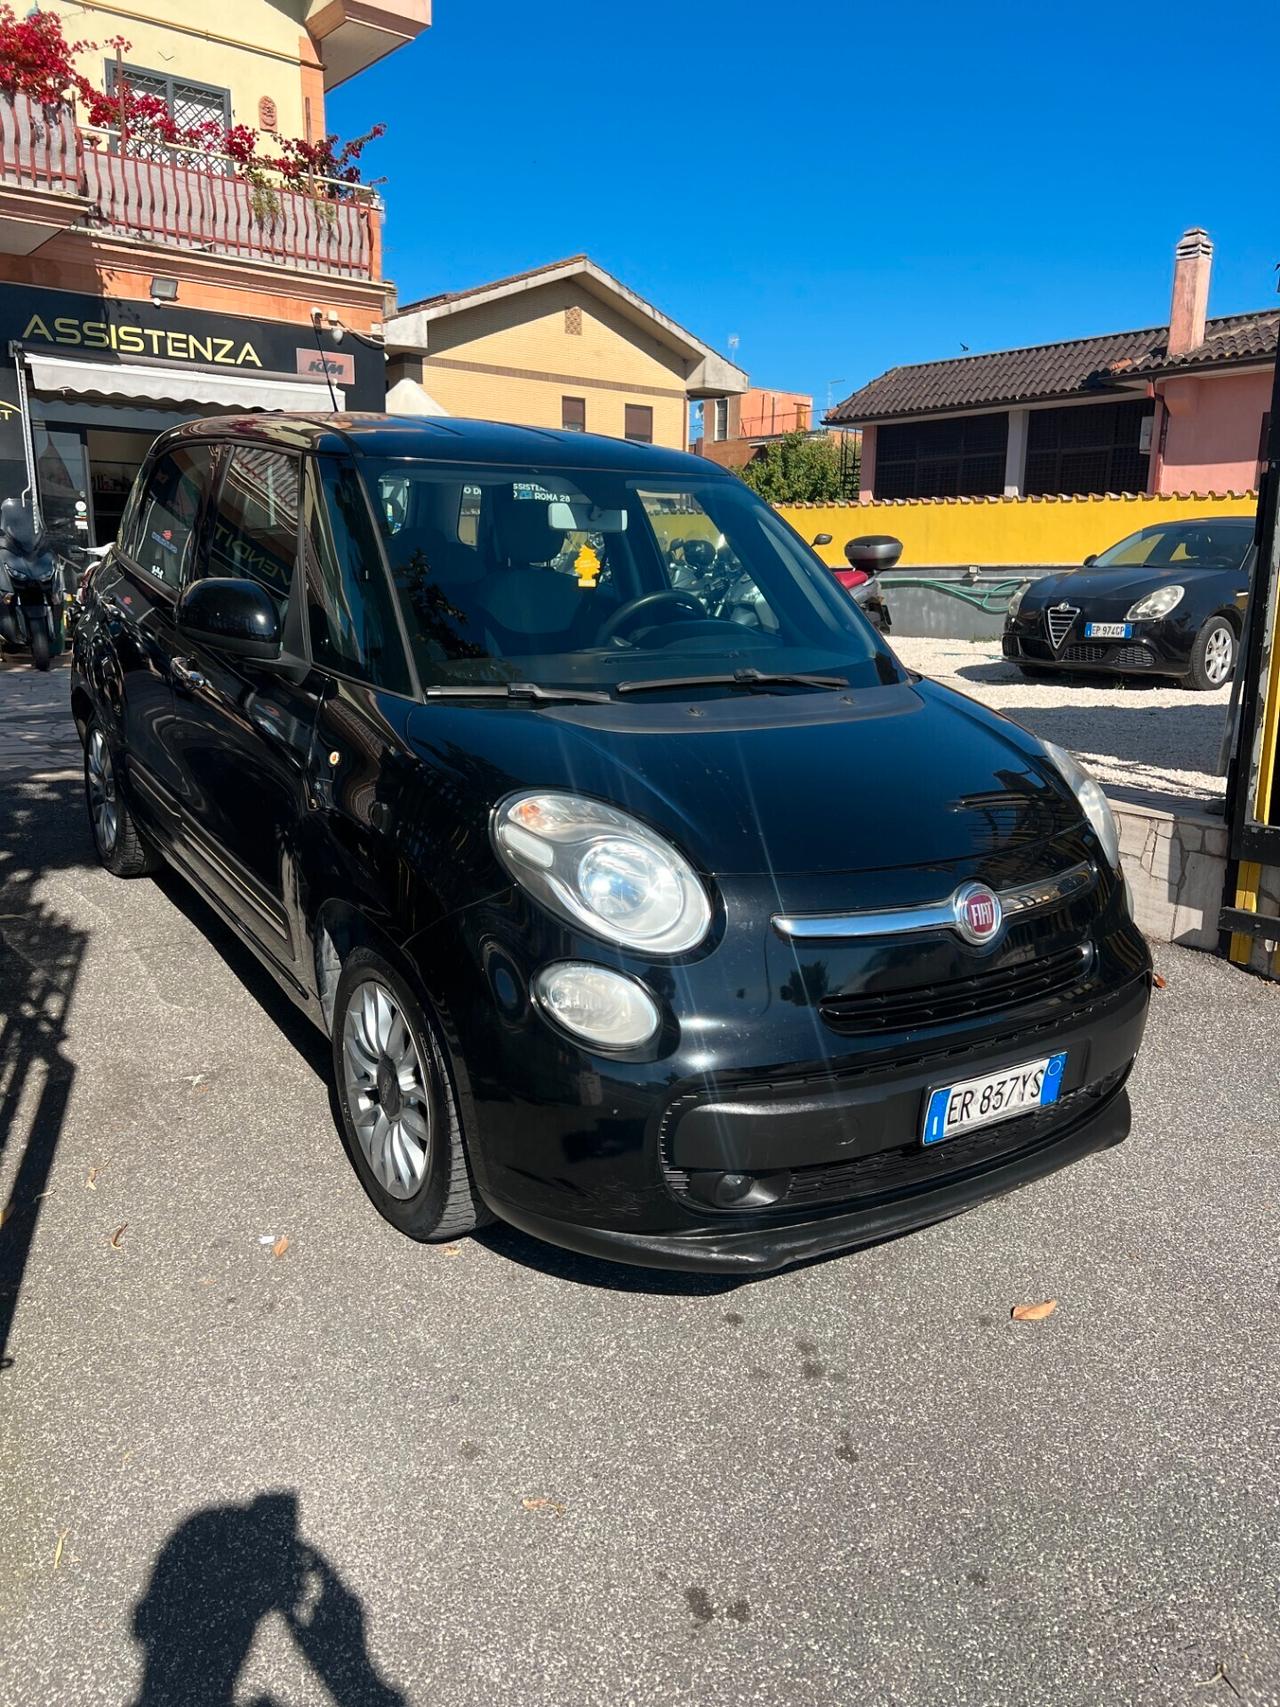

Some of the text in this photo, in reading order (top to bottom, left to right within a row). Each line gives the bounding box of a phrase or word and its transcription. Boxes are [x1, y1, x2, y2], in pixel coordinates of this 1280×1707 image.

[22, 313, 264, 368] ASSISTENZA
[308, 359, 344, 375] KTM
[534, 493, 558, 502] ROMA
[971, 901, 993, 927] FIAT
[947, 1090, 975, 1126] ER
[979, 1069, 1044, 1115] 837YS
